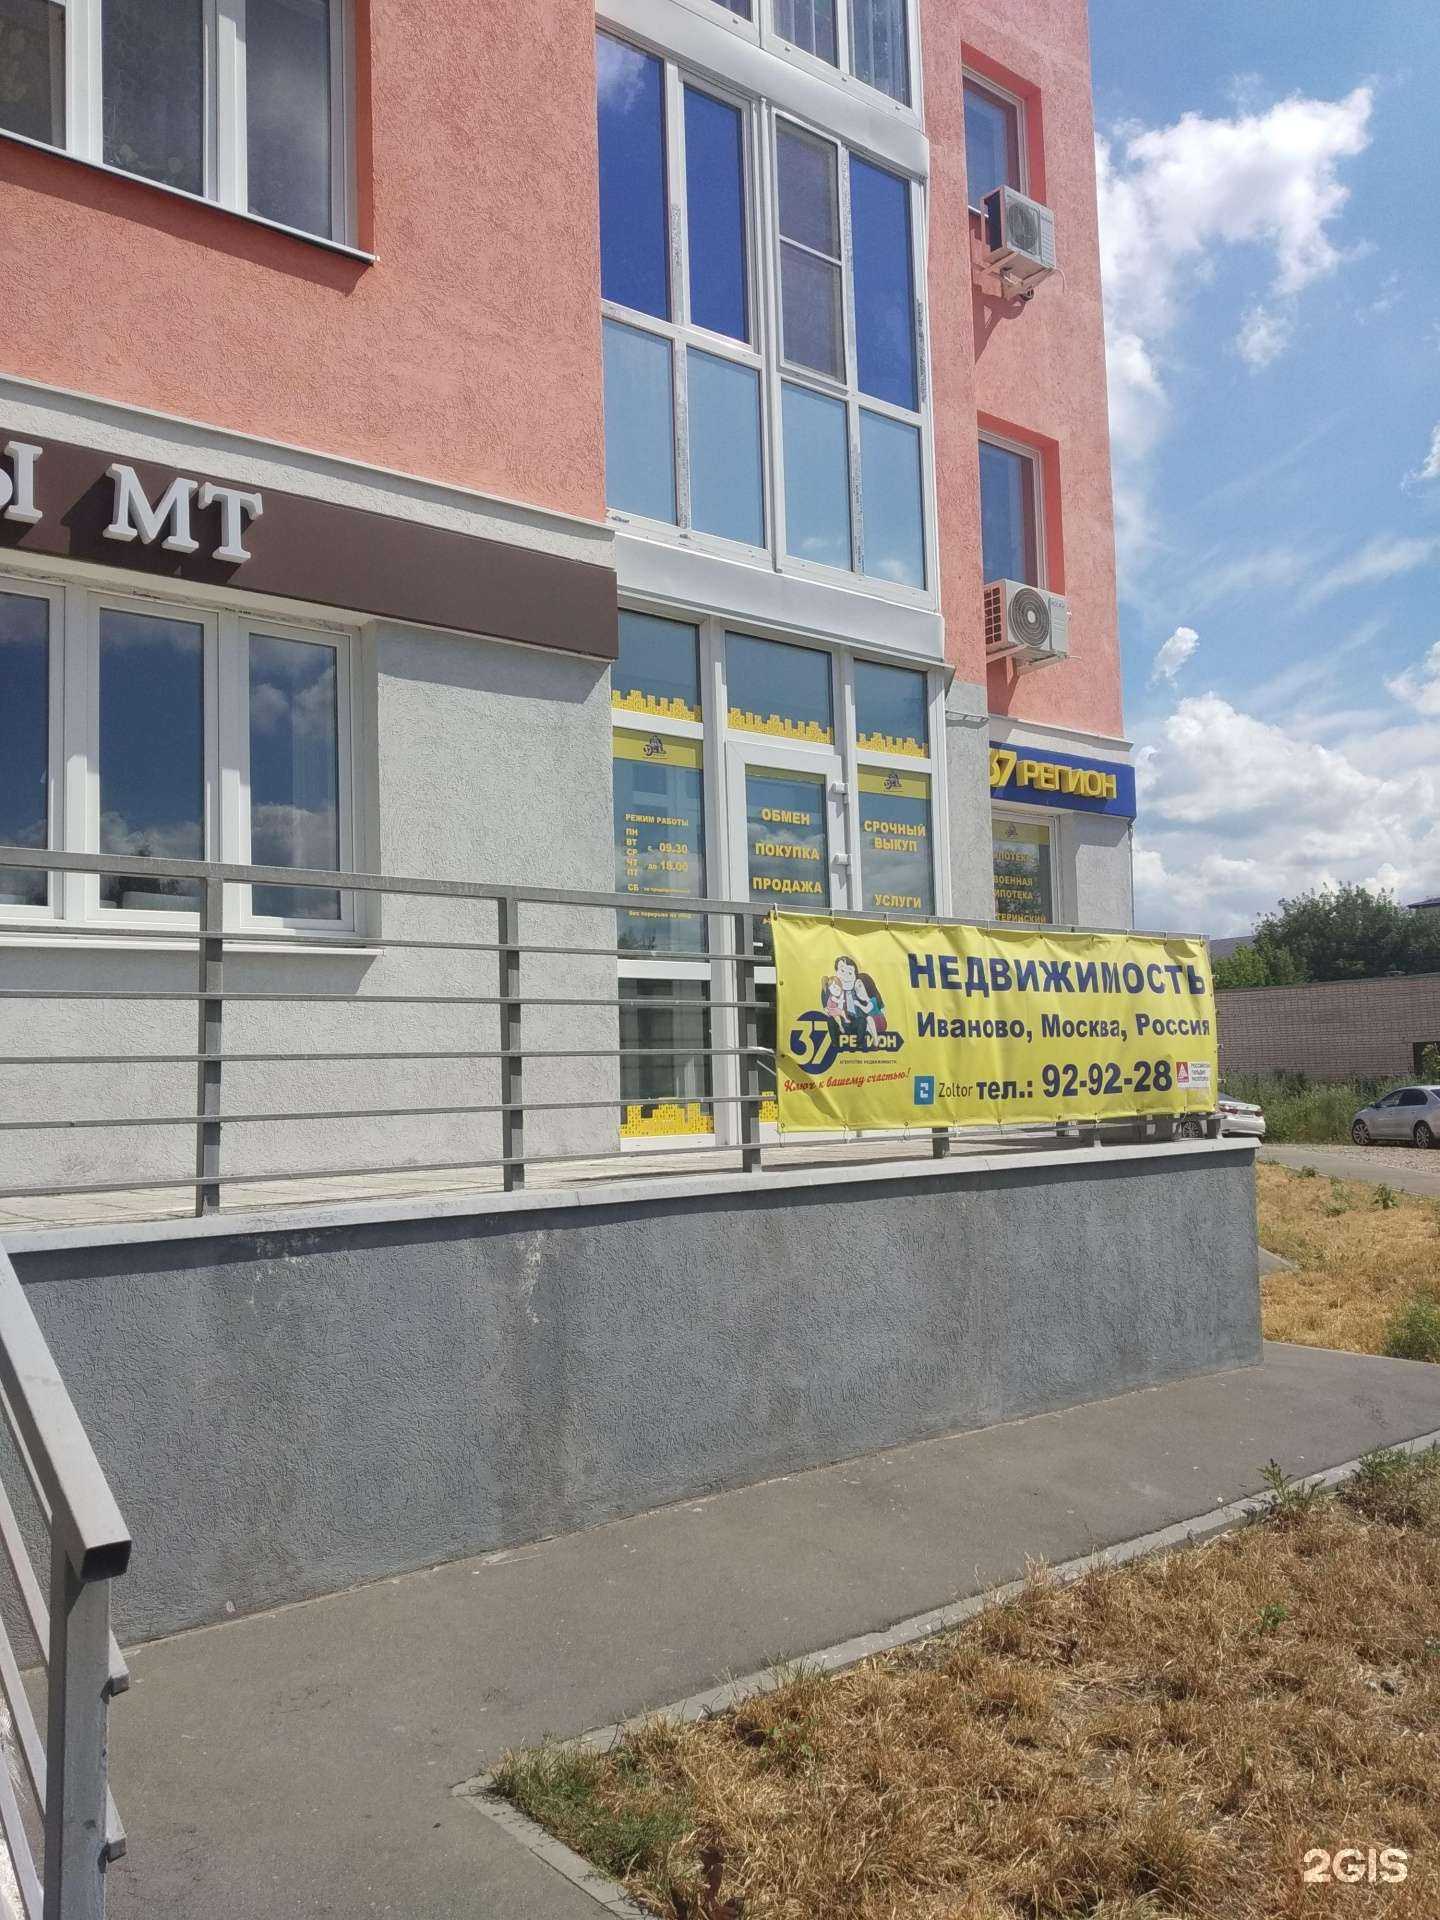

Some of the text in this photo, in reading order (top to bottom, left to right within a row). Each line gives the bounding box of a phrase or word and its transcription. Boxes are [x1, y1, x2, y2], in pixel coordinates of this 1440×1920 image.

[103, 463, 263, 563] МТ
[1016, 760, 1117, 799] РЕГИОН
[625, 813, 689, 826] РЕЖИМ РАБОТЫ
[761, 808, 810, 825] ОБМЕН
[626, 828, 639, 836] ПН
[864, 820, 926, 837] СРОЧНЫЙ
[626, 838, 637, 846] ВТ
[874, 837, 917, 851] ВЫКУП
[755, 843, 821, 860] ПОКУПКА
[752, 877, 823, 894] ПРОДАЖА
[874, 894, 922, 908] УСЛУГИ
[908, 953, 1206, 998] НЕДВИЖИМОСТЬ
[917, 1012, 1210, 1043] Иваново, Москва, Россия
[790, 1020, 832, 1066] 37
[839, 1034, 897, 1048] РЕИОН
[826, 1075, 865, 1088] вашему
[867, 1066, 912, 1084] счастью!
[976, 1060, 1172, 1100] тел.: 92-92-28
[938, 1083, 973, 1098] Zoltor
